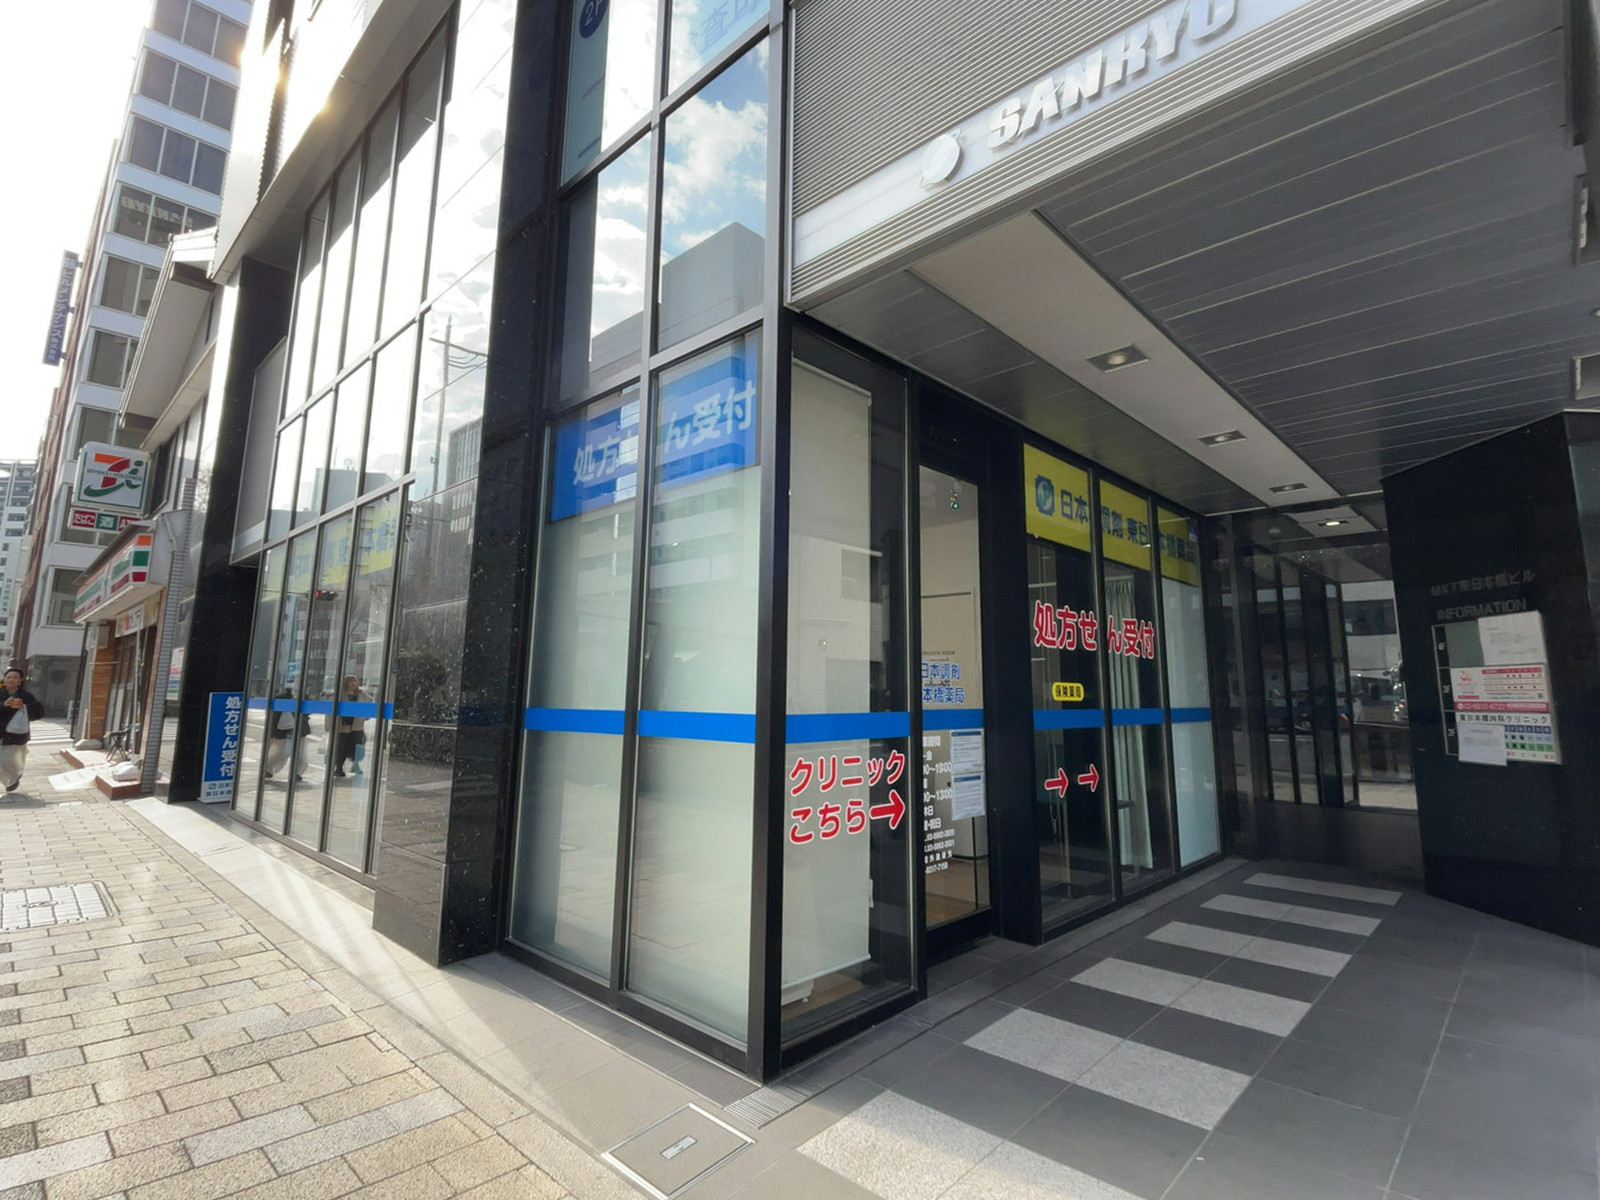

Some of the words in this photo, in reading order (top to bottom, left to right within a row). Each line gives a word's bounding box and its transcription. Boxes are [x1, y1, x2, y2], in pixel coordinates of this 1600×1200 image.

[1033, 599, 1155, 660] 処方せん受付
[1437, 598, 1528, 620] INFORMATION
[921, 663, 960, 680] 日本調剤
[219, 696, 242, 777] 処方せん受付
[789, 749, 905, 797] クリニック
[789, 799, 867, 845] こちら
